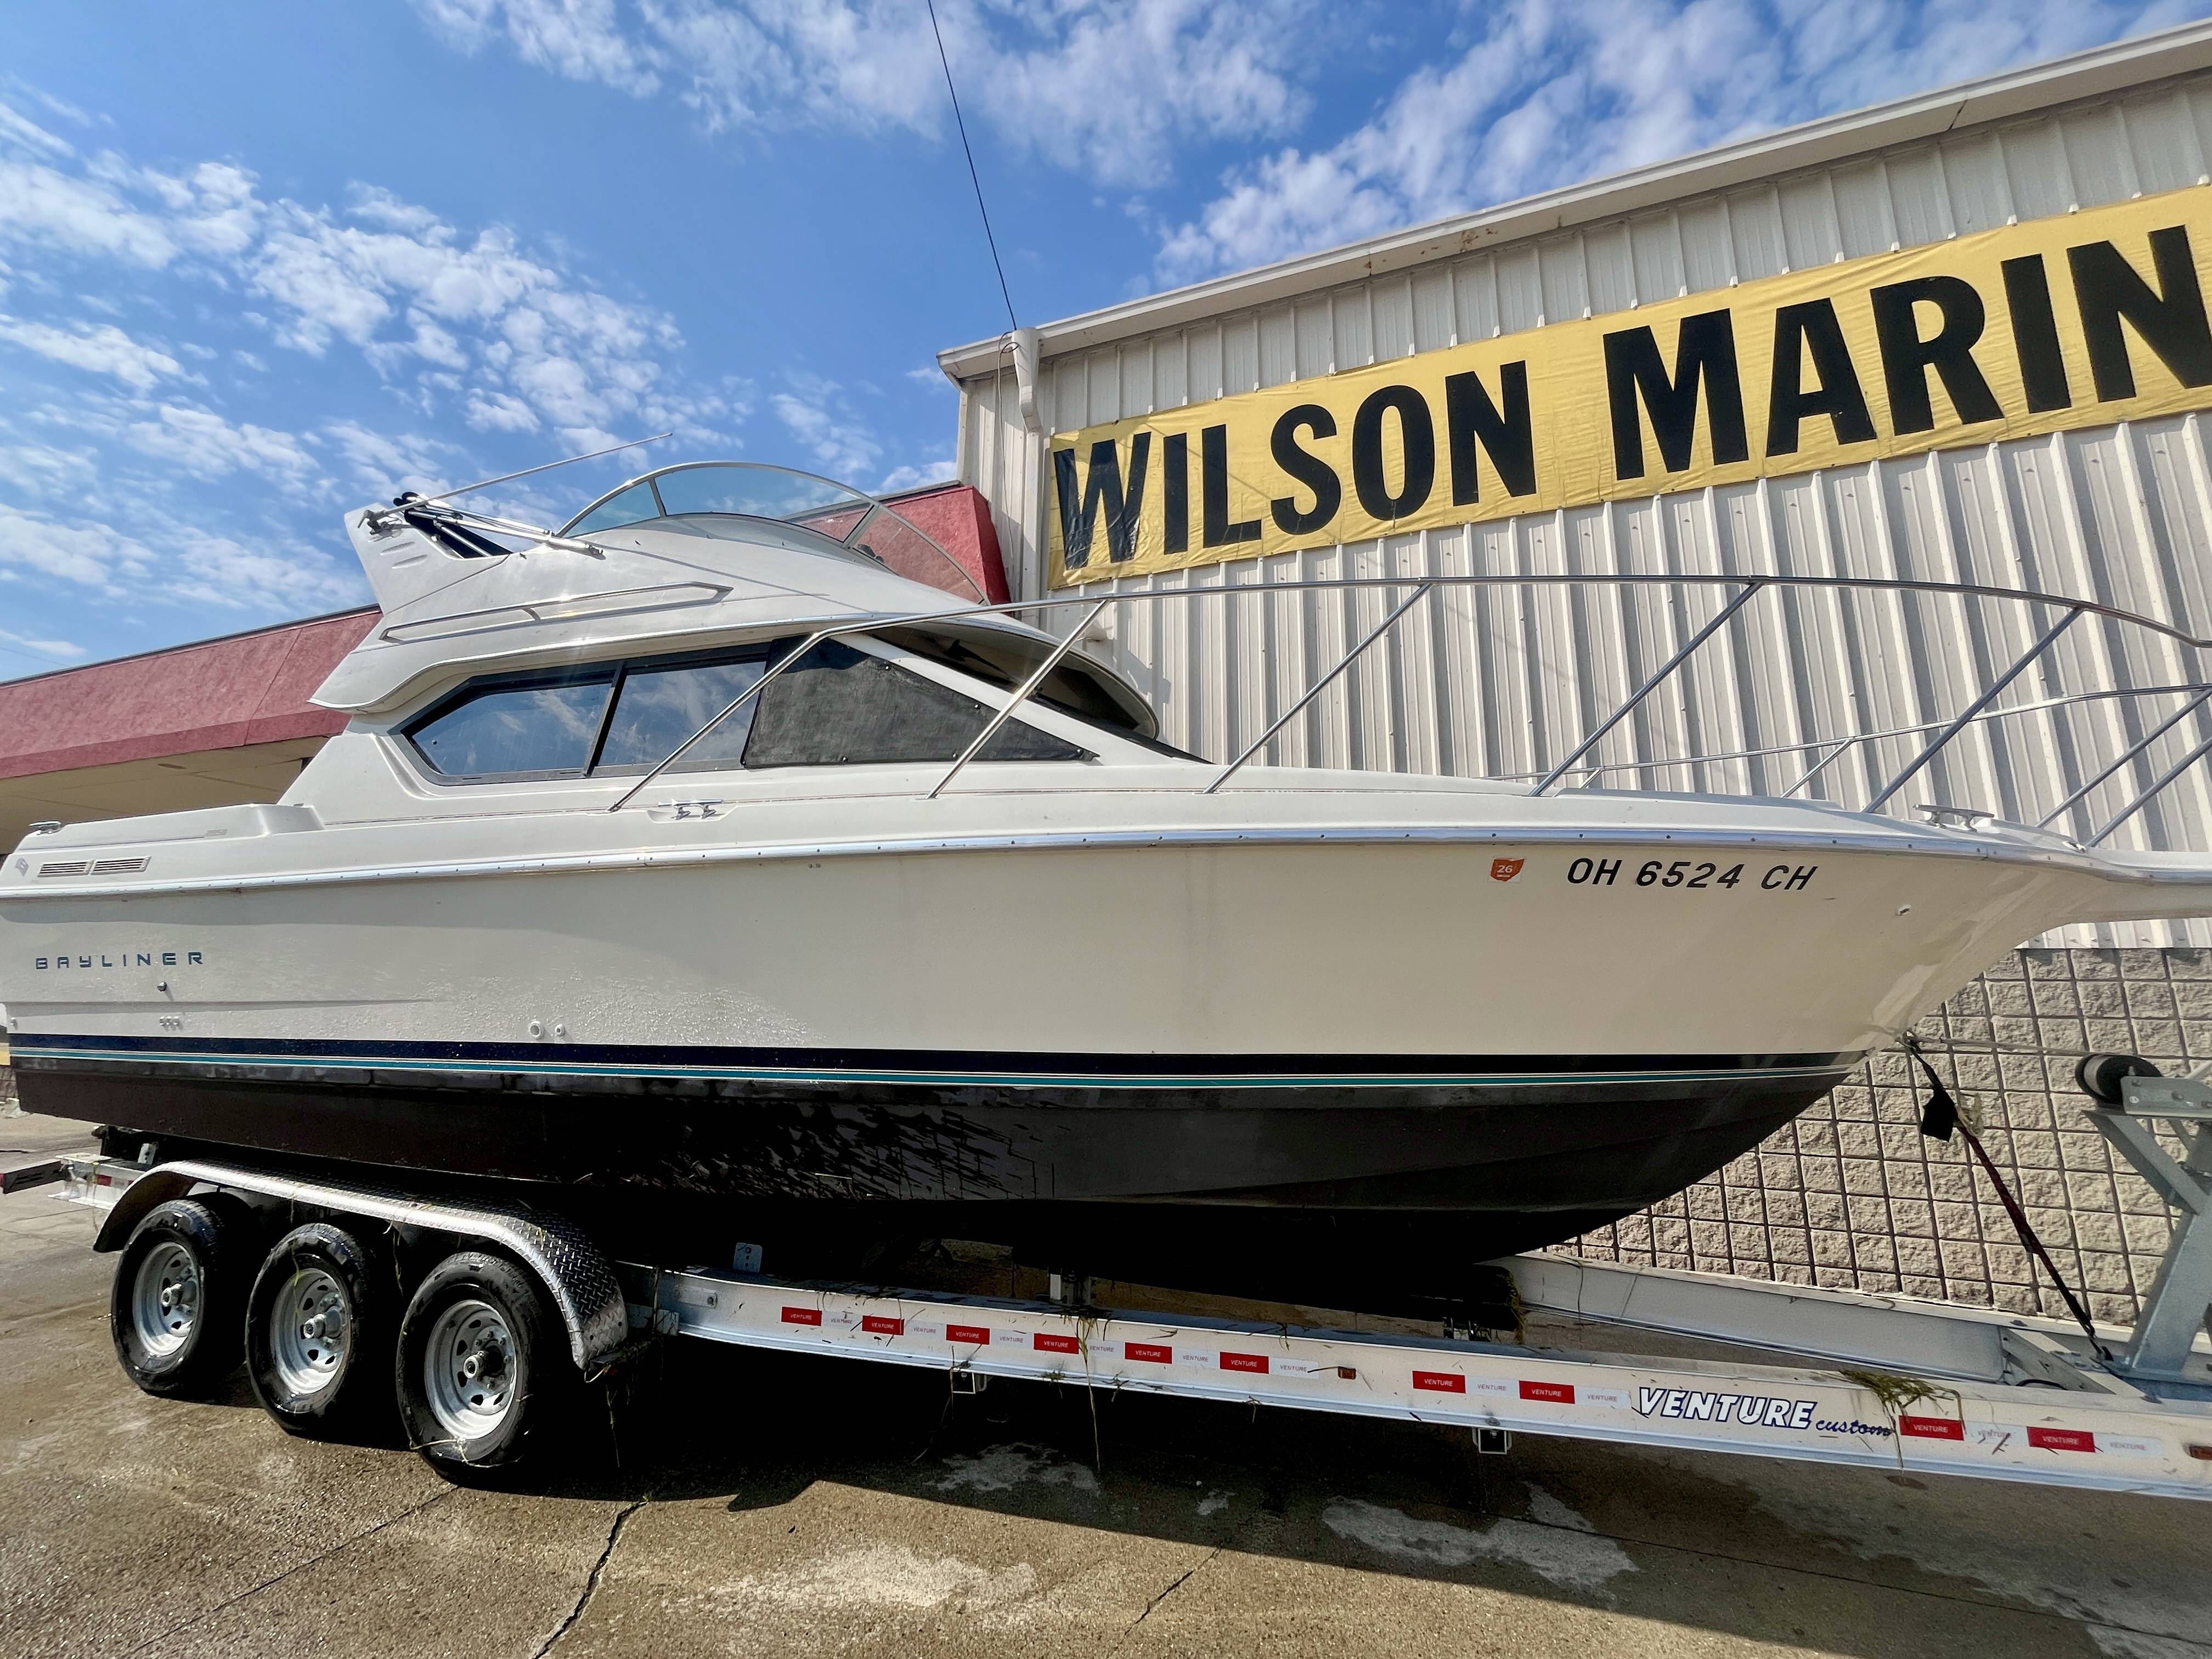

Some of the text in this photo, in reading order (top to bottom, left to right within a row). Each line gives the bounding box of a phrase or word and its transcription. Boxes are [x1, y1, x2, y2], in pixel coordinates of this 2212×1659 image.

[1052, 224, 2212, 569] WILSON MARIN
[1497, 865, 1513, 873] 26
[1567, 857, 1818, 891] OH 6524 CH
[36, 951, 204, 970] BAYLINER
[1532, 1389, 1562, 1397] VENTURE
[1587, 1394, 1617, 1402] VENTURE
[1639, 1386, 1894, 1437] VENTURE custom
[1914, 1425, 1948, 1433] VENTURE
[2043, 1436, 2079, 1445] VENTURE
